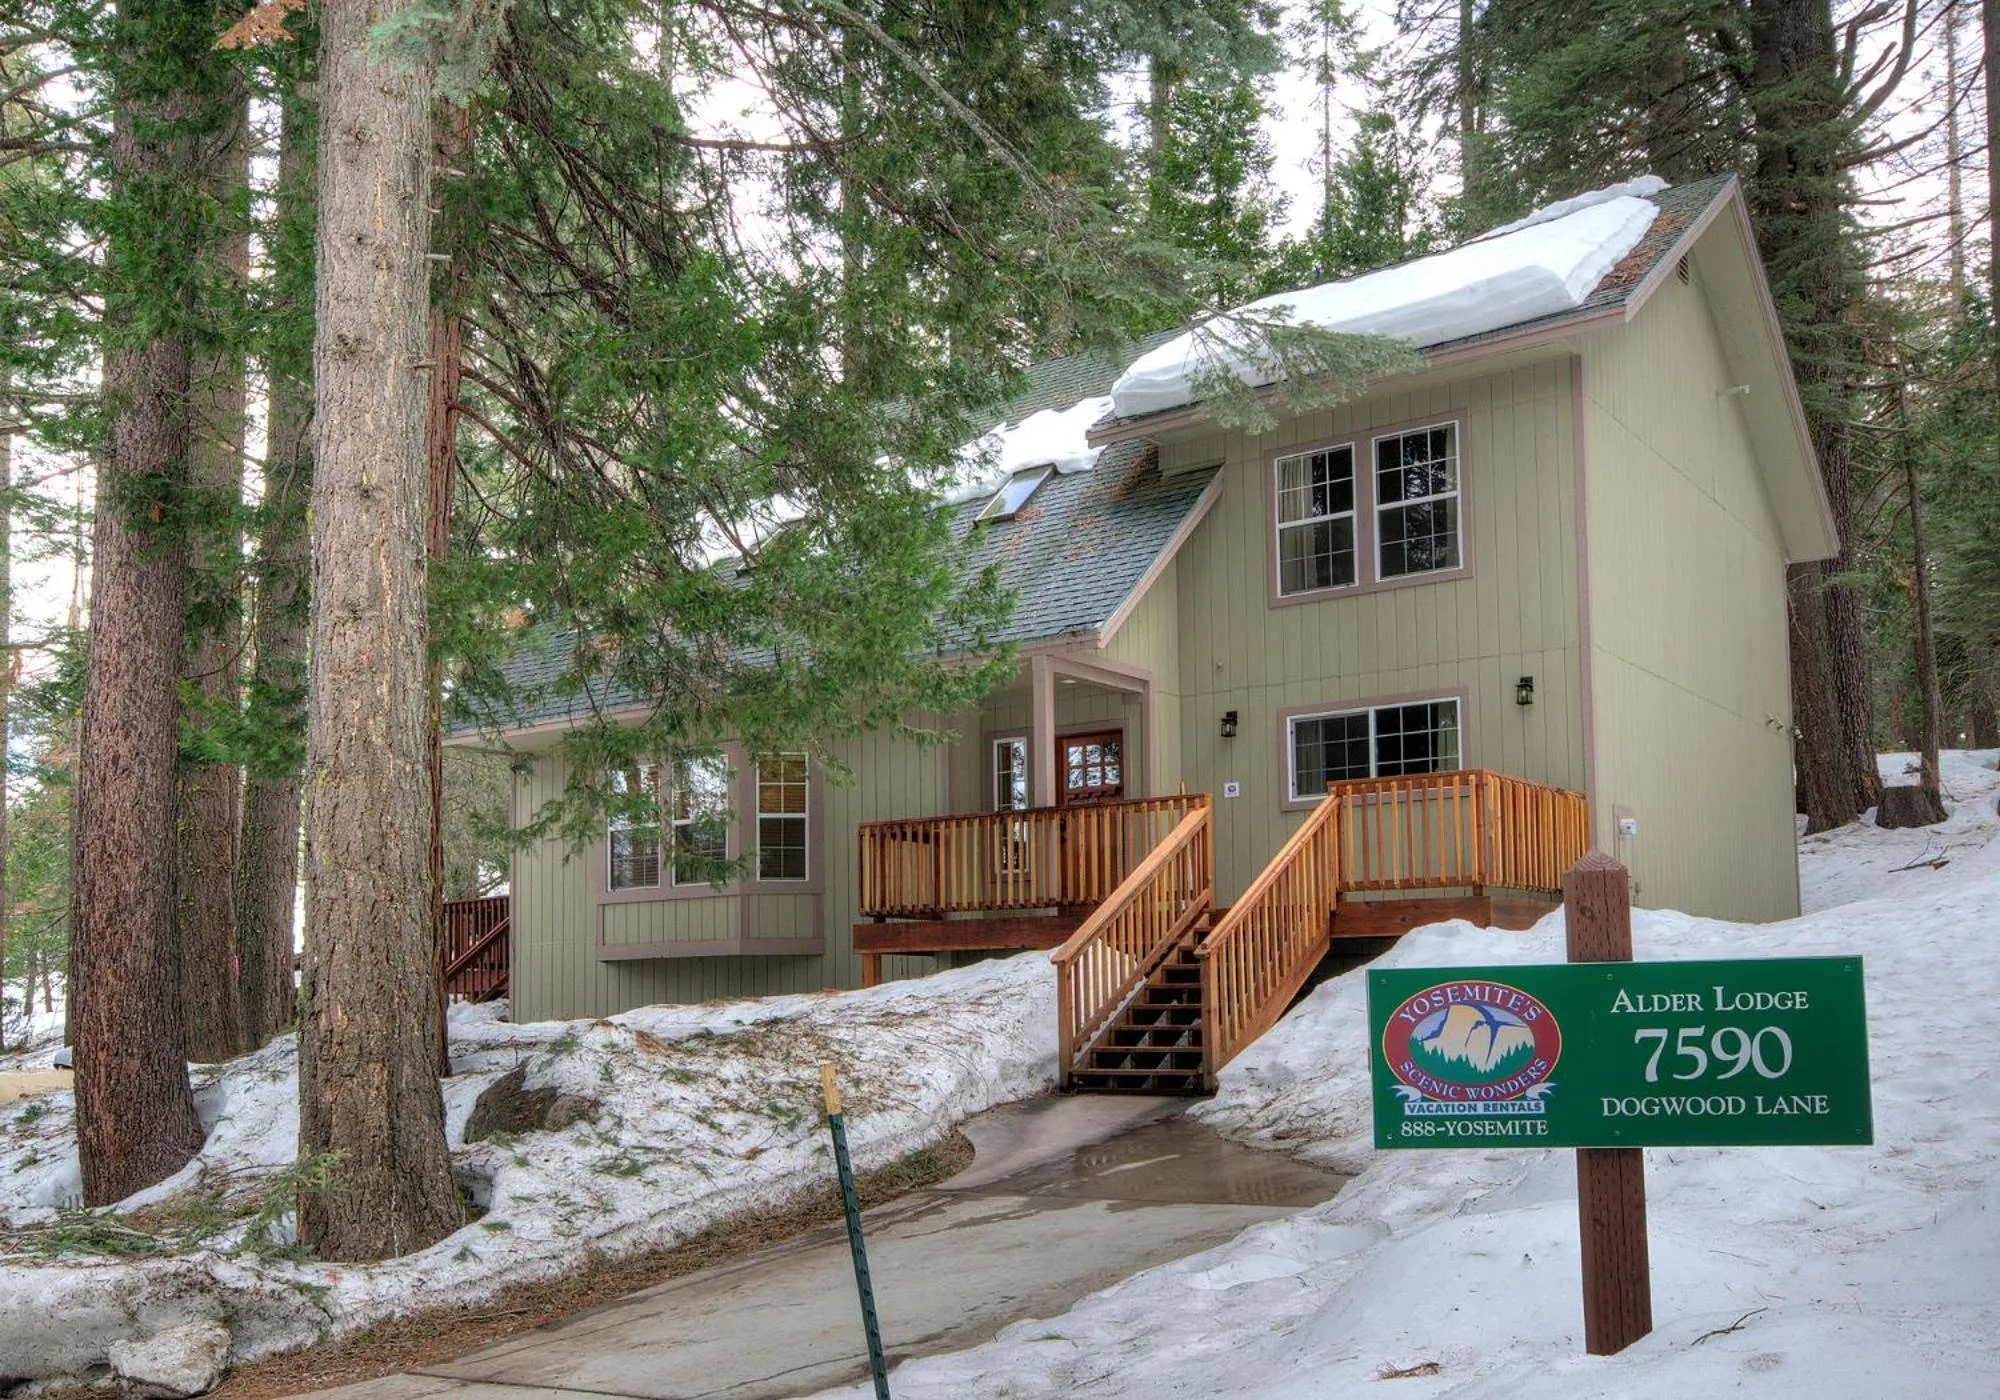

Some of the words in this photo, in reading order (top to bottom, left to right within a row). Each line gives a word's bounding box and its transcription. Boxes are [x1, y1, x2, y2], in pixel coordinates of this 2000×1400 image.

[1400, 983, 1543, 1024] YOSEMITE'S
[1634, 1025, 1793, 1083] 7590
[1400, 1060, 1461, 1100] SCENIC
[1464, 1057, 1549, 1101] WONDERS
[1407, 1102, 1478, 1113] VACATION
[1483, 1101, 1542, 1112] RENTALS
[1600, 1096, 1746, 1117] DOGWOOD
[1757, 1095, 1830, 1115] LANE
[1401, 1119, 1549, 1137] 888-YOSEMITE
